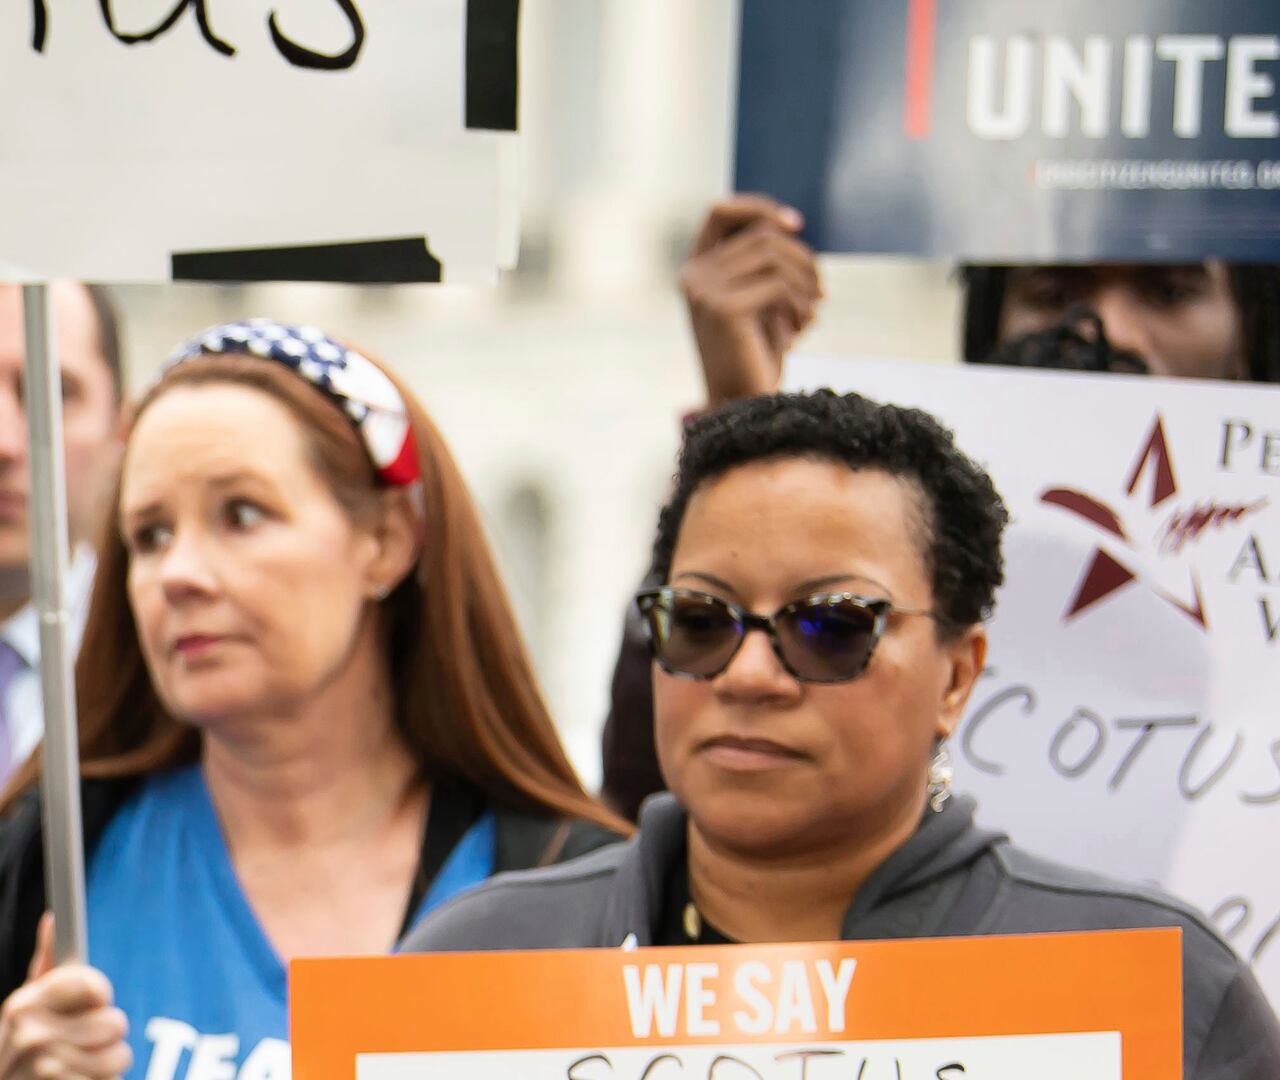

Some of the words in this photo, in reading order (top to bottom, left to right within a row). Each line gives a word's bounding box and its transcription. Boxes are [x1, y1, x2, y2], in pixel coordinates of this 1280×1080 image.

[966, 33, 1280, 140] UNITE
[624, 964, 721, 1039] WE
[731, 958, 858, 1034] SAY
